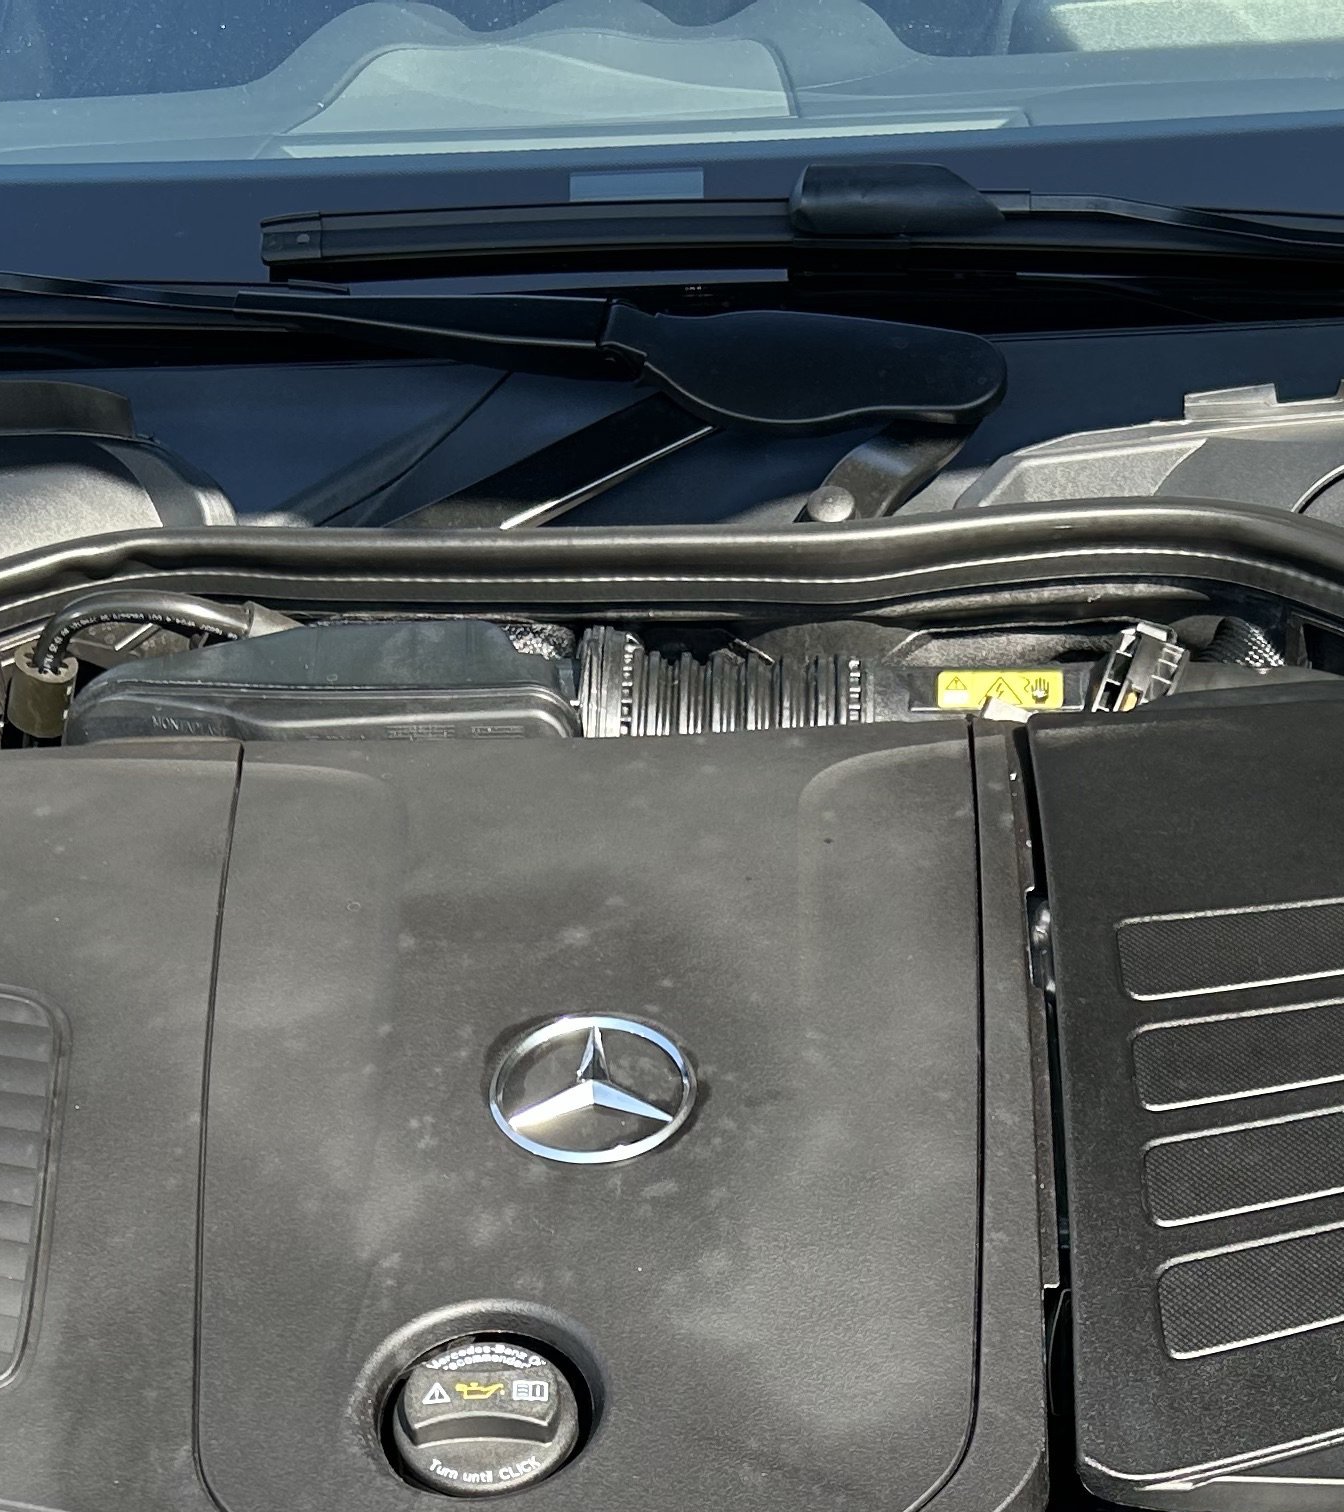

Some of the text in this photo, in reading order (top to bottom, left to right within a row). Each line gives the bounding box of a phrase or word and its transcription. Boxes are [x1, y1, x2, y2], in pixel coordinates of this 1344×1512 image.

[427, 1455, 542, 1484] Turn until CLICK
